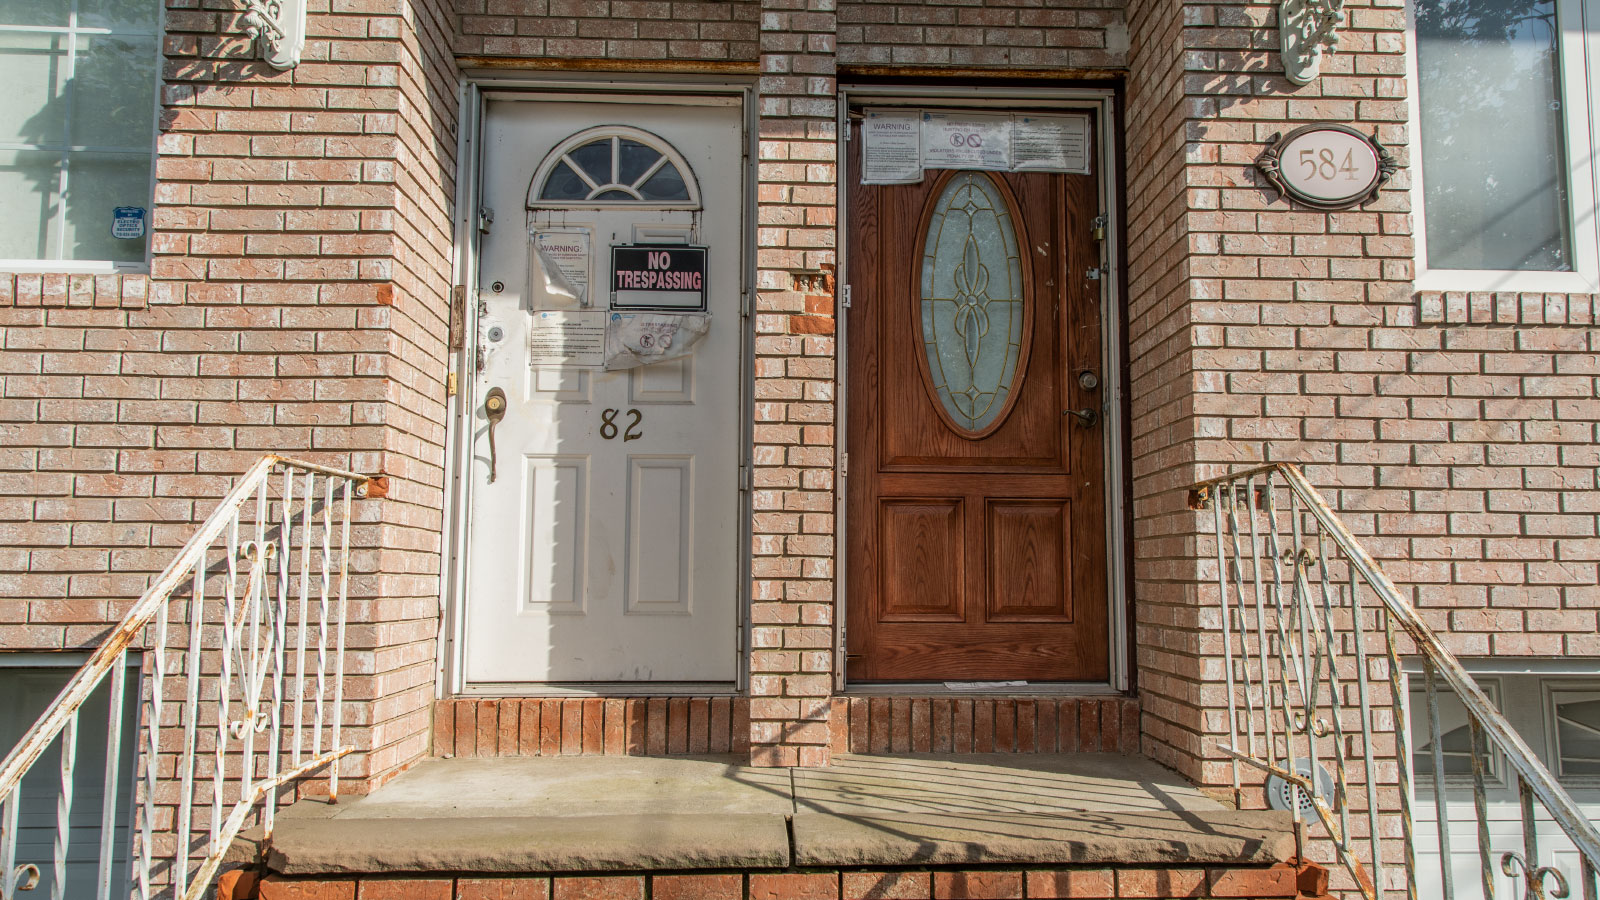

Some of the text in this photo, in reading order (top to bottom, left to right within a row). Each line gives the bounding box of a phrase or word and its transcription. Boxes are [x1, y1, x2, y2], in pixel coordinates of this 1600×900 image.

[1299, 147, 1359, 181] 584
[648, 251, 671, 270] NO
[617, 270, 701, 289] TRESPASSING
[600, 408, 643, 443] 82
